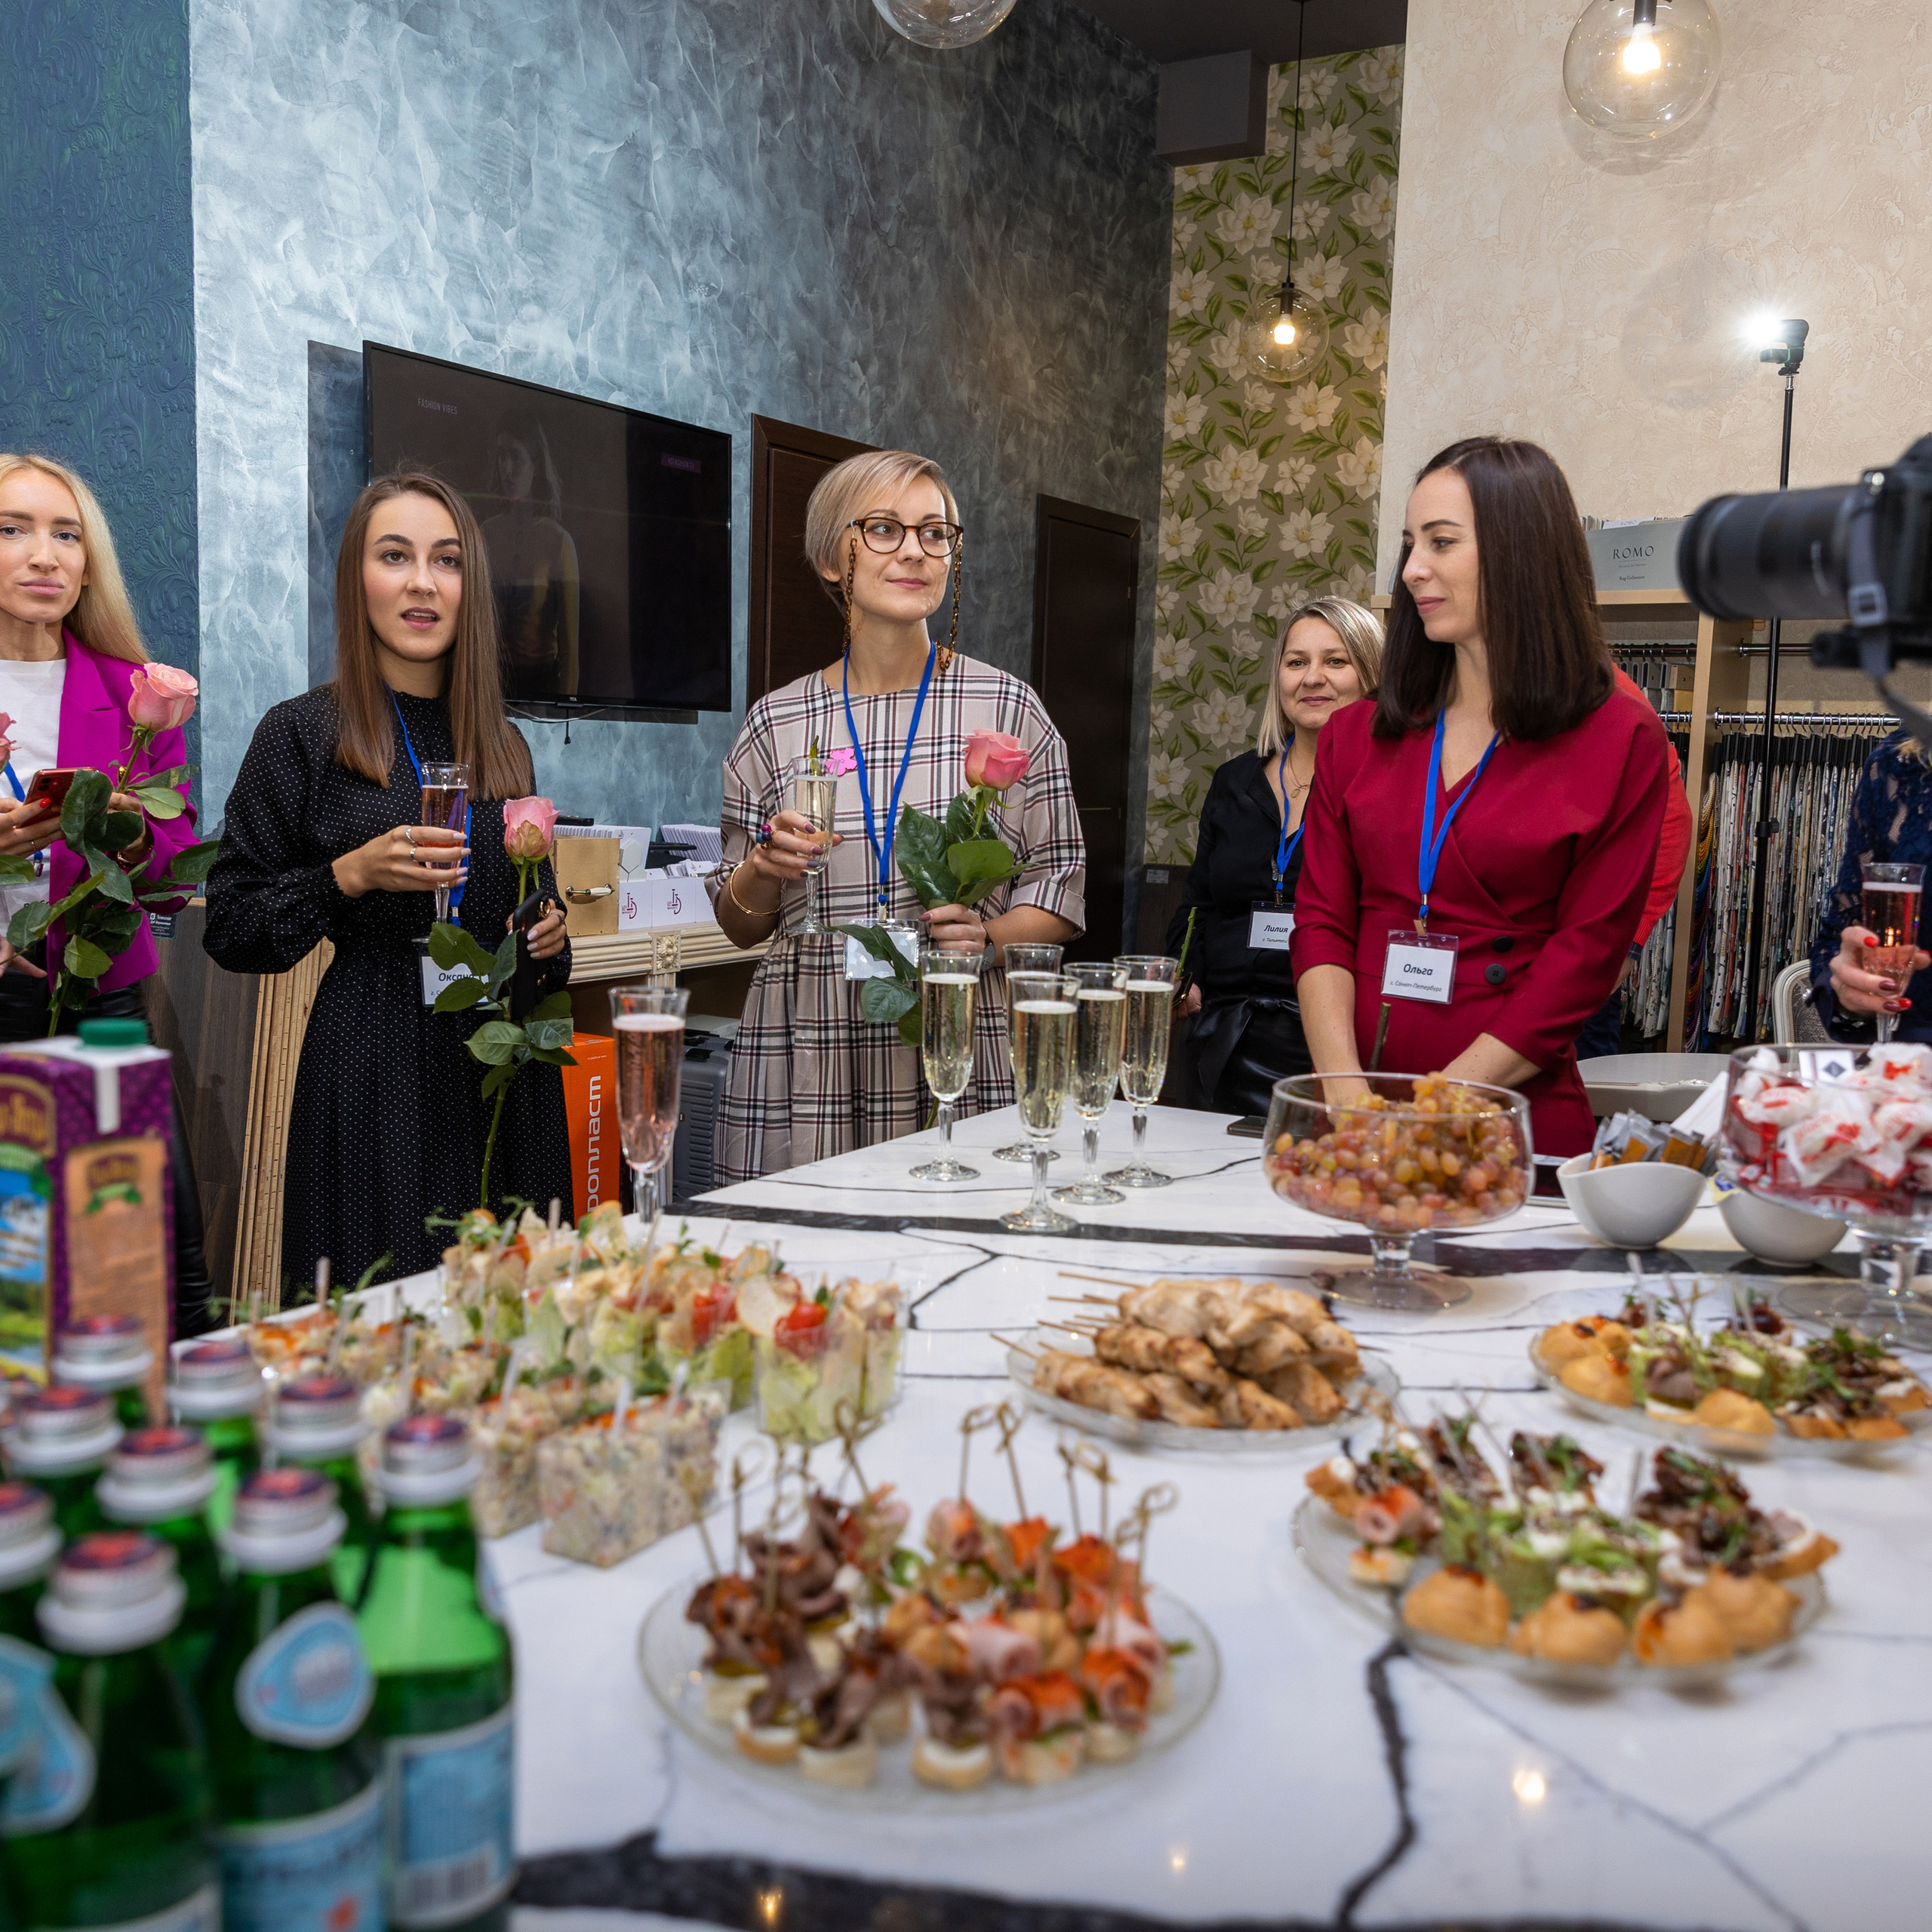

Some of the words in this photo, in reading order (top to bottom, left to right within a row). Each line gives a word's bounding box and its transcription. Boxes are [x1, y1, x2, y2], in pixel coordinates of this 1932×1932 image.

[417, 397, 441, 411] FASHION
[442, 403, 458, 415] VIBES
[1613, 546, 1654, 559] ROMO
[1263, 924, 1288, 933] Лилия
[1403, 964, 1433, 976] Ольга
[1395, 980, 1442, 992] Санкт-Петербург
